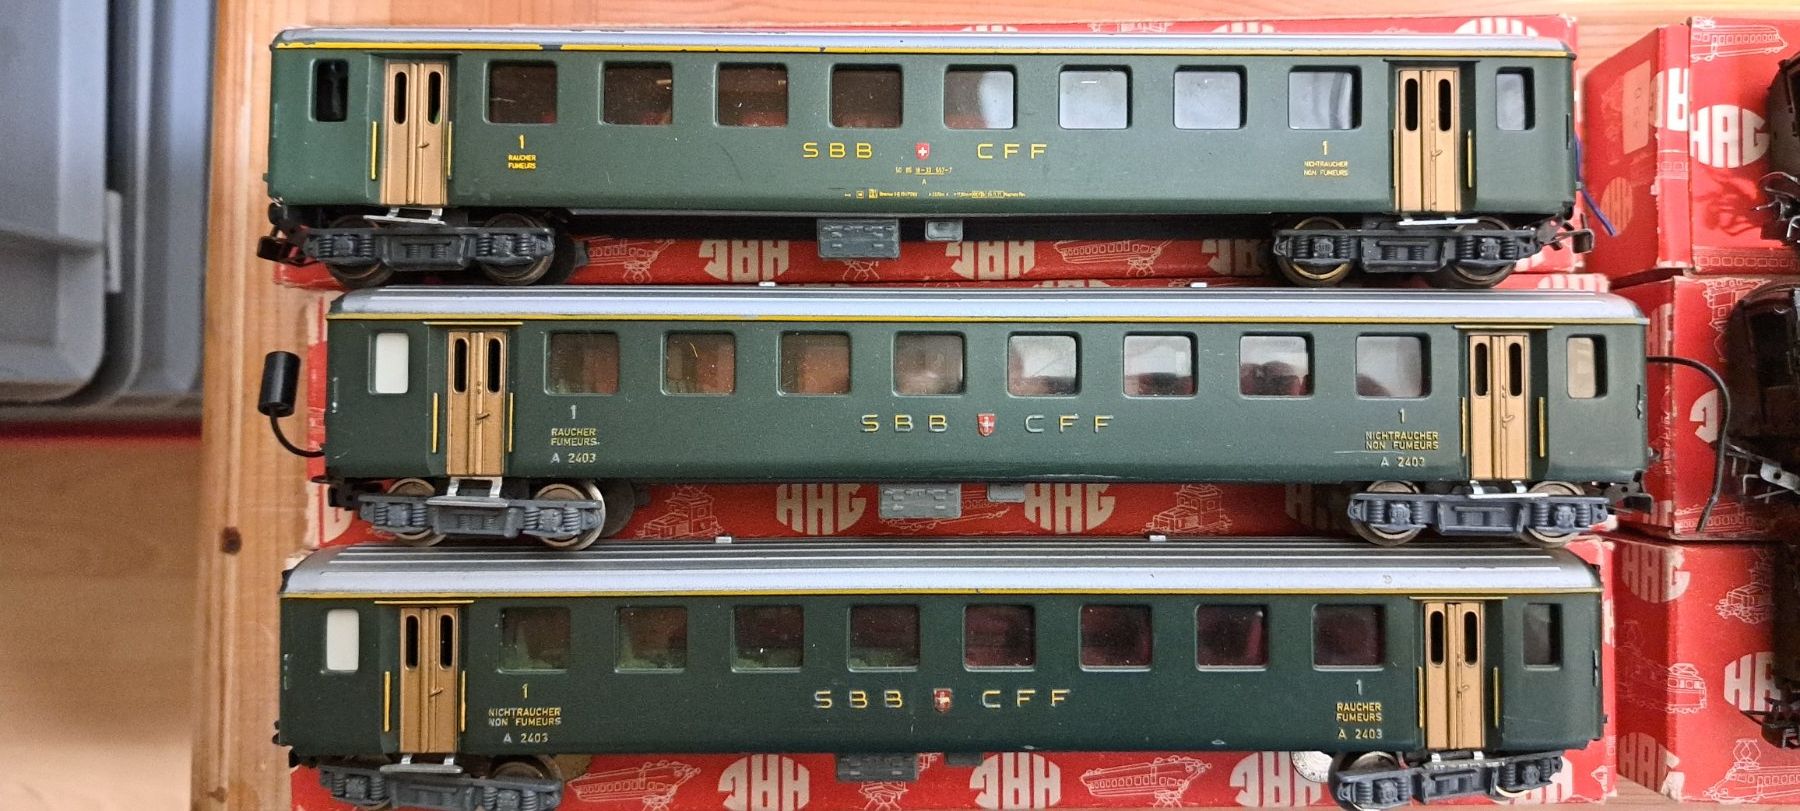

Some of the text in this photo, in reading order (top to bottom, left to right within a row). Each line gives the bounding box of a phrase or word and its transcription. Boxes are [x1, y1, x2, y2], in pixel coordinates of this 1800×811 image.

[519, 134, 525, 149] 1
[1690, 104, 1770, 169] HAG
[802, 142, 1048, 160] SBB CFF
[1322, 140, 1328, 155] 1
[698, 240, 789, 281] HAG
[945, 240, 1032, 281] HAG
[570, 404, 577, 420] 1
[1399, 408, 1405, 423] 1
[860, 413, 1114, 433] SBB CFF
[551, 427, 597, 436] RAUCHER
[1365, 431, 1438, 441] NICHTRAUCHER
[1365, 441, 1439, 450] NON FUMEURS
[550, 452, 597, 464] A 2403
[1381, 456, 1425, 467] A 2403
[1622, 544, 1691, 604] HAG
[1356, 679, 1362, 696] 1
[1724, 652, 1782, 711] HA
[522, 683, 528, 699] 1
[813, 689, 1071, 709] SBB CFF
[488, 706, 561, 716] NICHTRAUCHER
[1336, 702, 1382, 712] RAUCHER
[488, 717, 562, 727] NON FUMEURS
[1336, 712, 1382, 721] FUMEURS
[503, 732, 549, 743] A 2403
[1338, 728, 1383, 740] A 2403
[717, 753, 809, 811] HAG
[970, 751, 1060, 810] HAG
